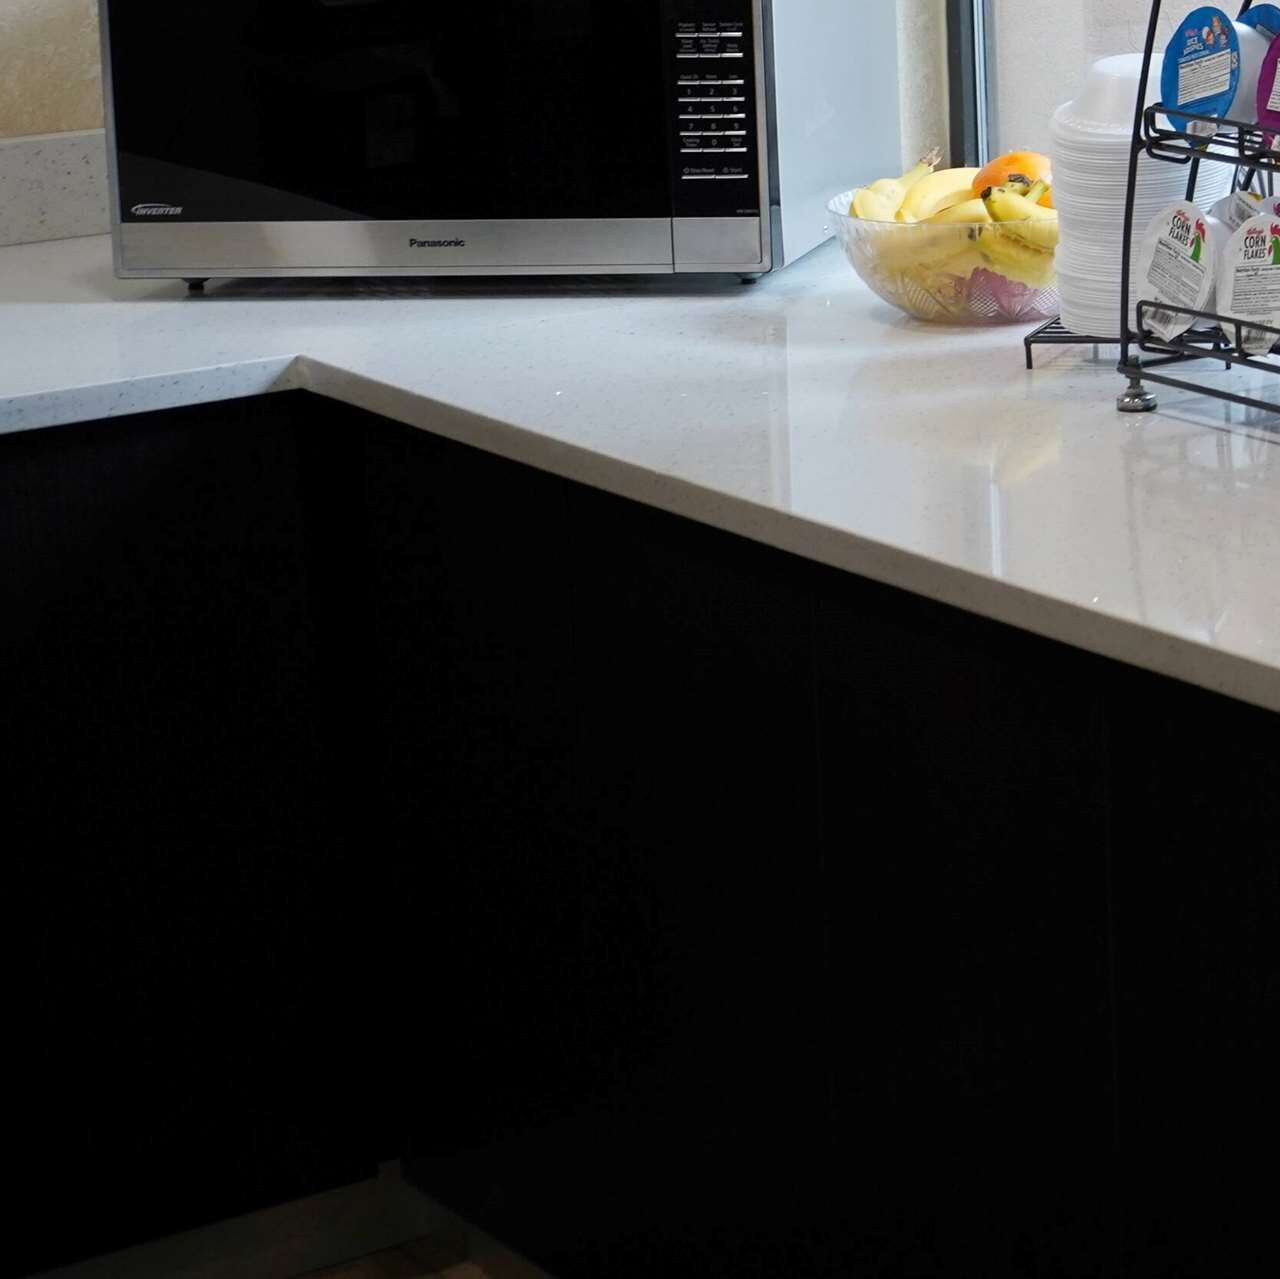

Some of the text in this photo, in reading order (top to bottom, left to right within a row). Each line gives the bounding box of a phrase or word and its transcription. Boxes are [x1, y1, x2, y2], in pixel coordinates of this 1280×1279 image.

[135, 206, 184, 216] INVERTER
[1172, 215, 1192, 236] CORN
[409, 238, 466, 248] Panasonic
[1168, 227, 1190, 246] FLAKES
[1244, 235, 1267, 249] CORN
[1243, 248, 1267, 260] FLAKES
